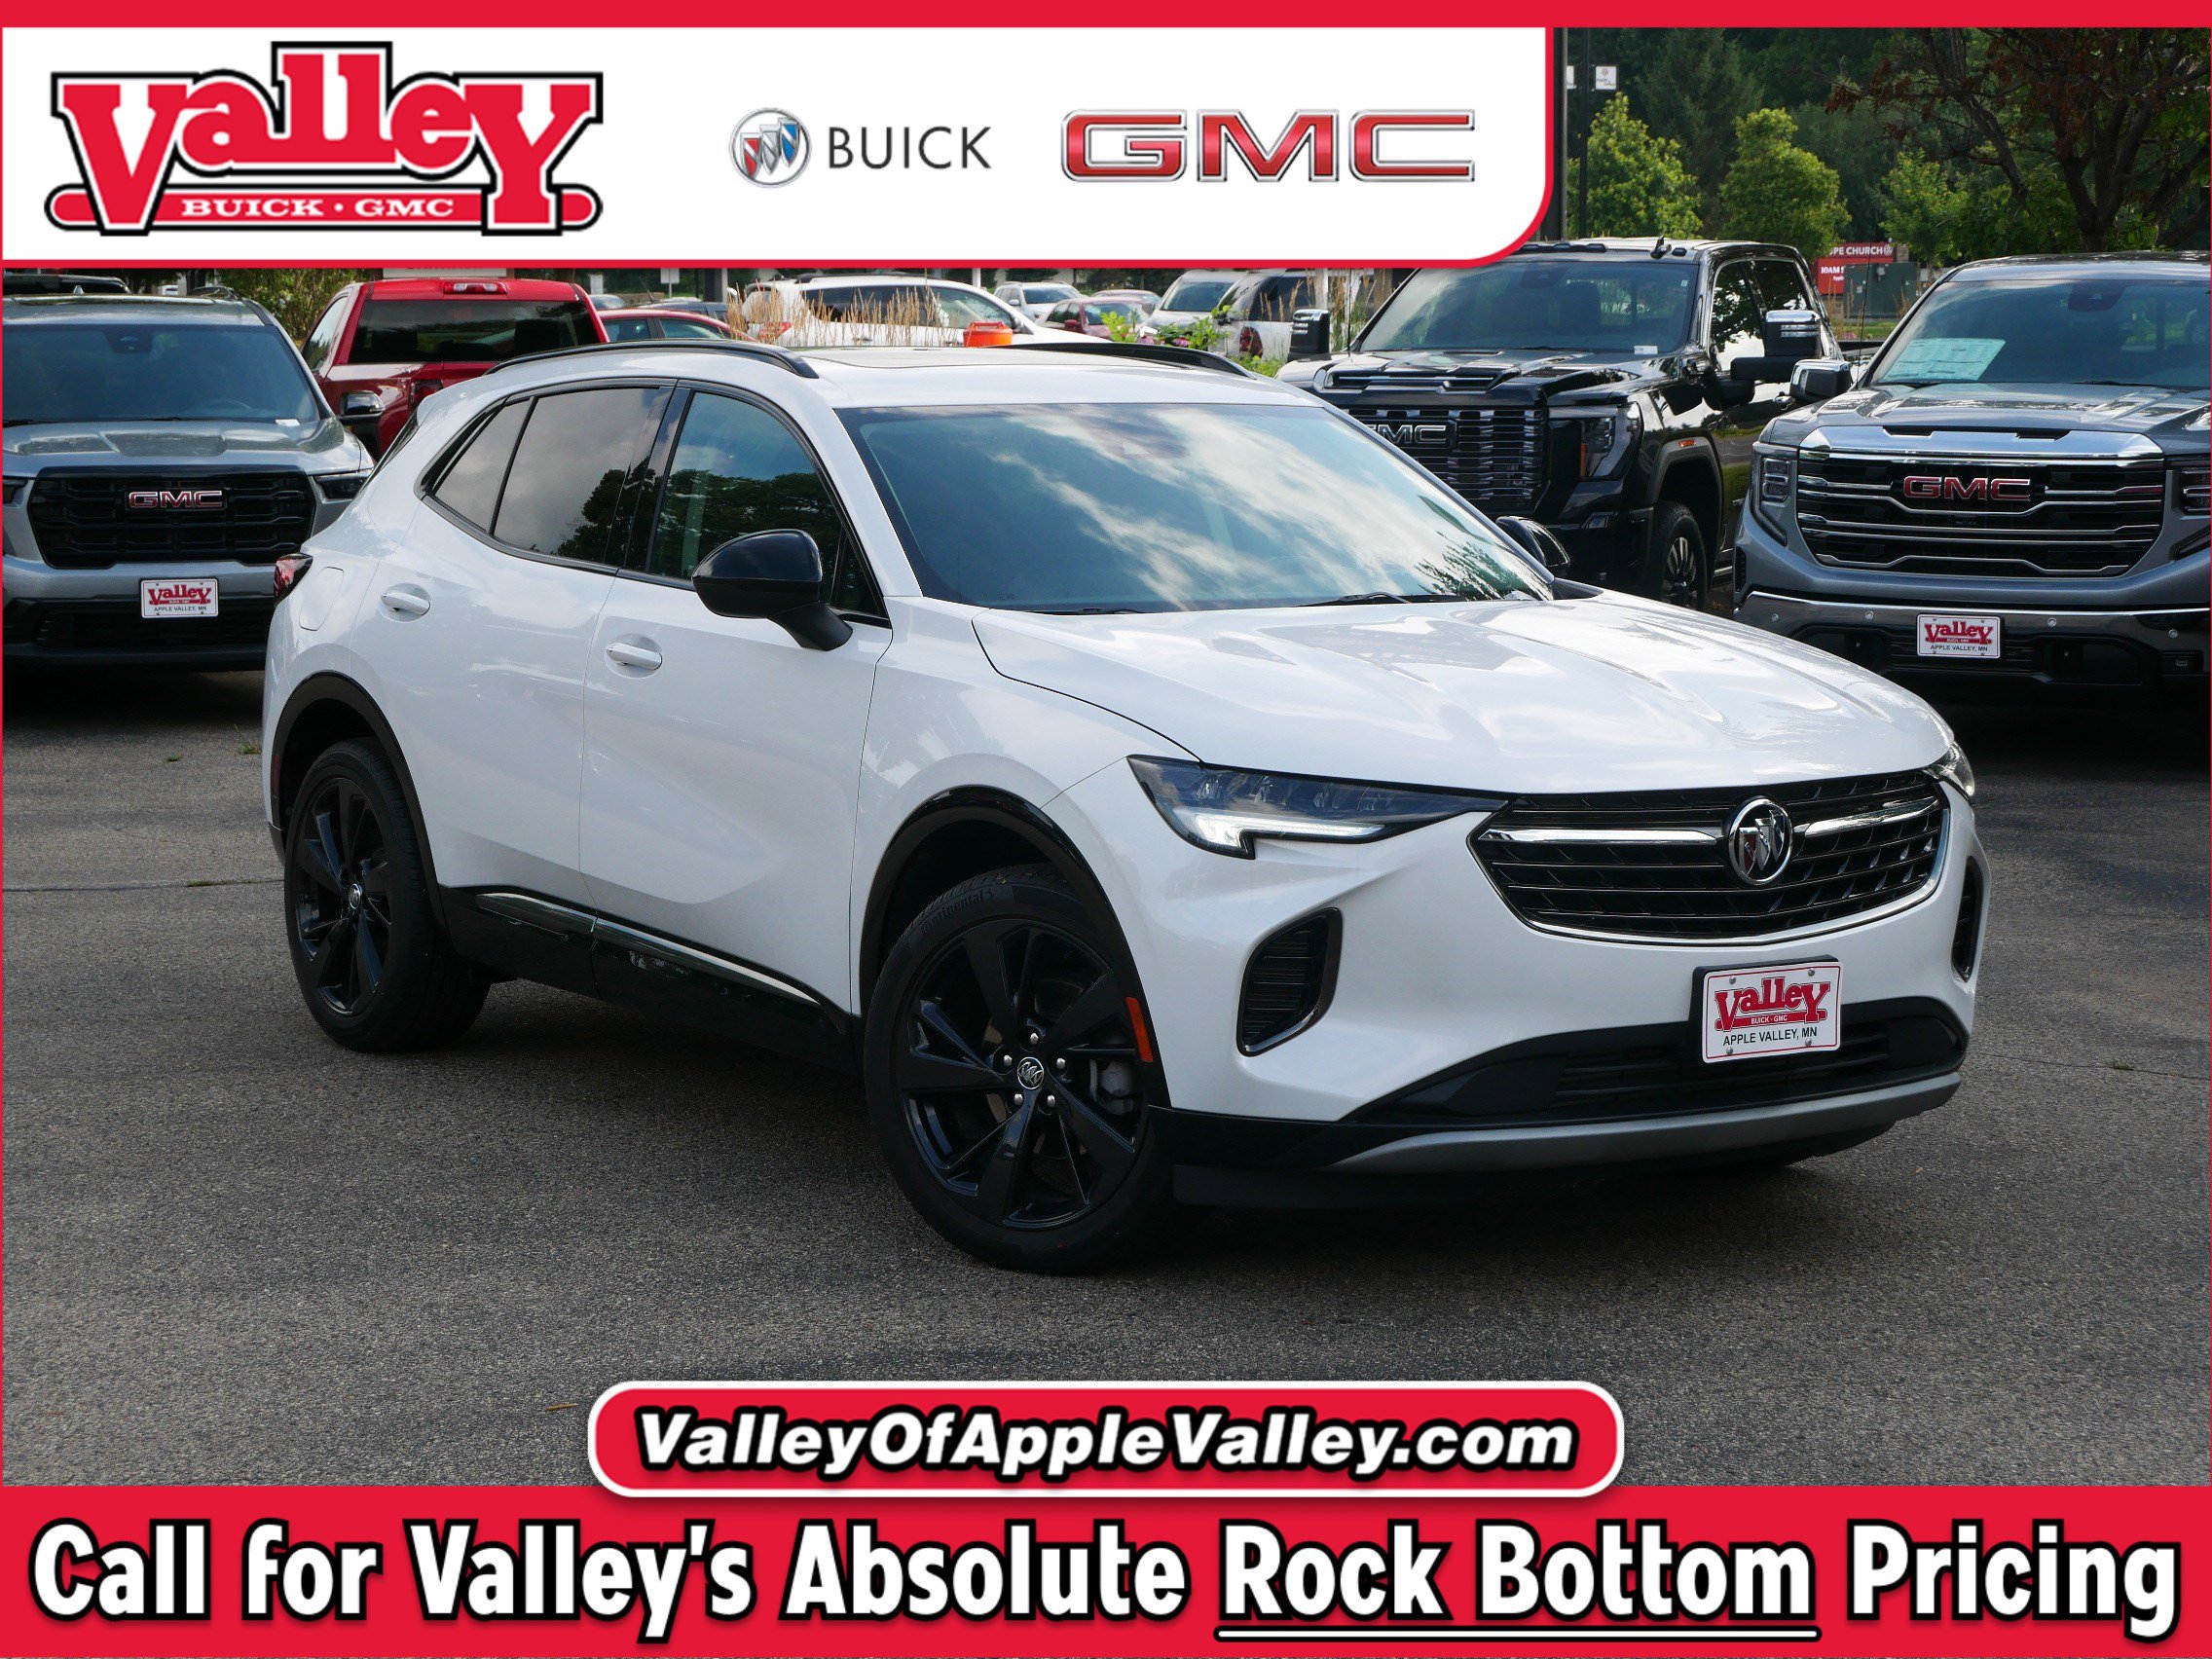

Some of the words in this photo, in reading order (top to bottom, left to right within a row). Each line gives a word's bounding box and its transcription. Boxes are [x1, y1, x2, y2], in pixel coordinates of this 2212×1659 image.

[1829, 246, 1844, 256] PE
[1846, 246, 1883, 255] CHURCH
[1366, 424, 1447, 444] MC
[1903, 475, 2031, 501] GMC
[129, 490, 223, 508] GMC
[1722, 1030, 1756, 1047] APPLE
[1758, 1027, 1800, 1043] VALLEY,
[1801, 1026, 1818, 1038] MN
